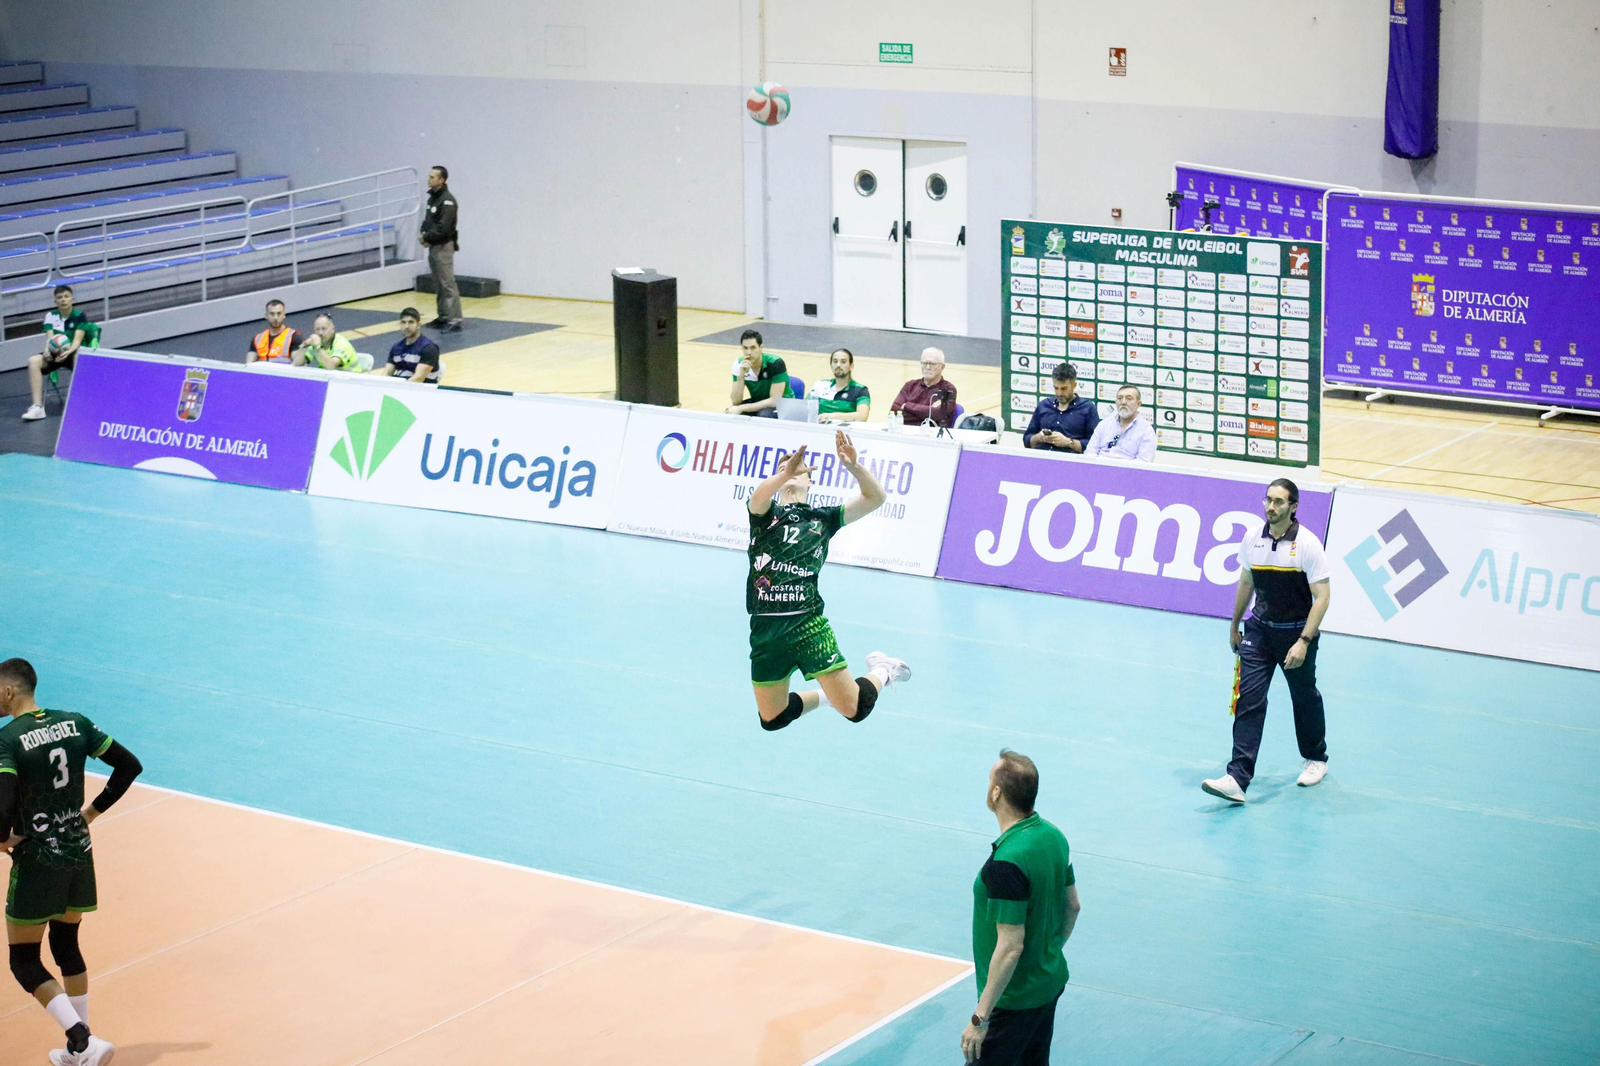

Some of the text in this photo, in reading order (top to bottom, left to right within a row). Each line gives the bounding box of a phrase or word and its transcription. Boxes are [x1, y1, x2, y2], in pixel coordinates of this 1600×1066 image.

[880, 53, 912, 62] EMERGENCIA
[881, 44, 912, 53] SALIDA DE
[1072, 230, 1243, 255] SUPERLIGA DE VOLEIBOL
[1115, 249, 1198, 267] MASCULINA
[1442, 288, 1530, 309] DIPUTACIÓN
[1443, 305, 1527, 324] DE ALMERÍA
[98, 420, 269, 460] DIPUTACIÓN DE ALMERÍA
[420, 432, 597, 509] Unicaja
[733, 484, 746, 501] TU
[627, 523, 648, 534] Nueva
[782, 524, 800, 544] 12
[763, 590, 806, 602] ALMERÍA
[770, 584, 805, 592] COSTA DE
[19, 720, 81, 751] RODRÍGUEZ
[49, 746, 69, 790] 3
